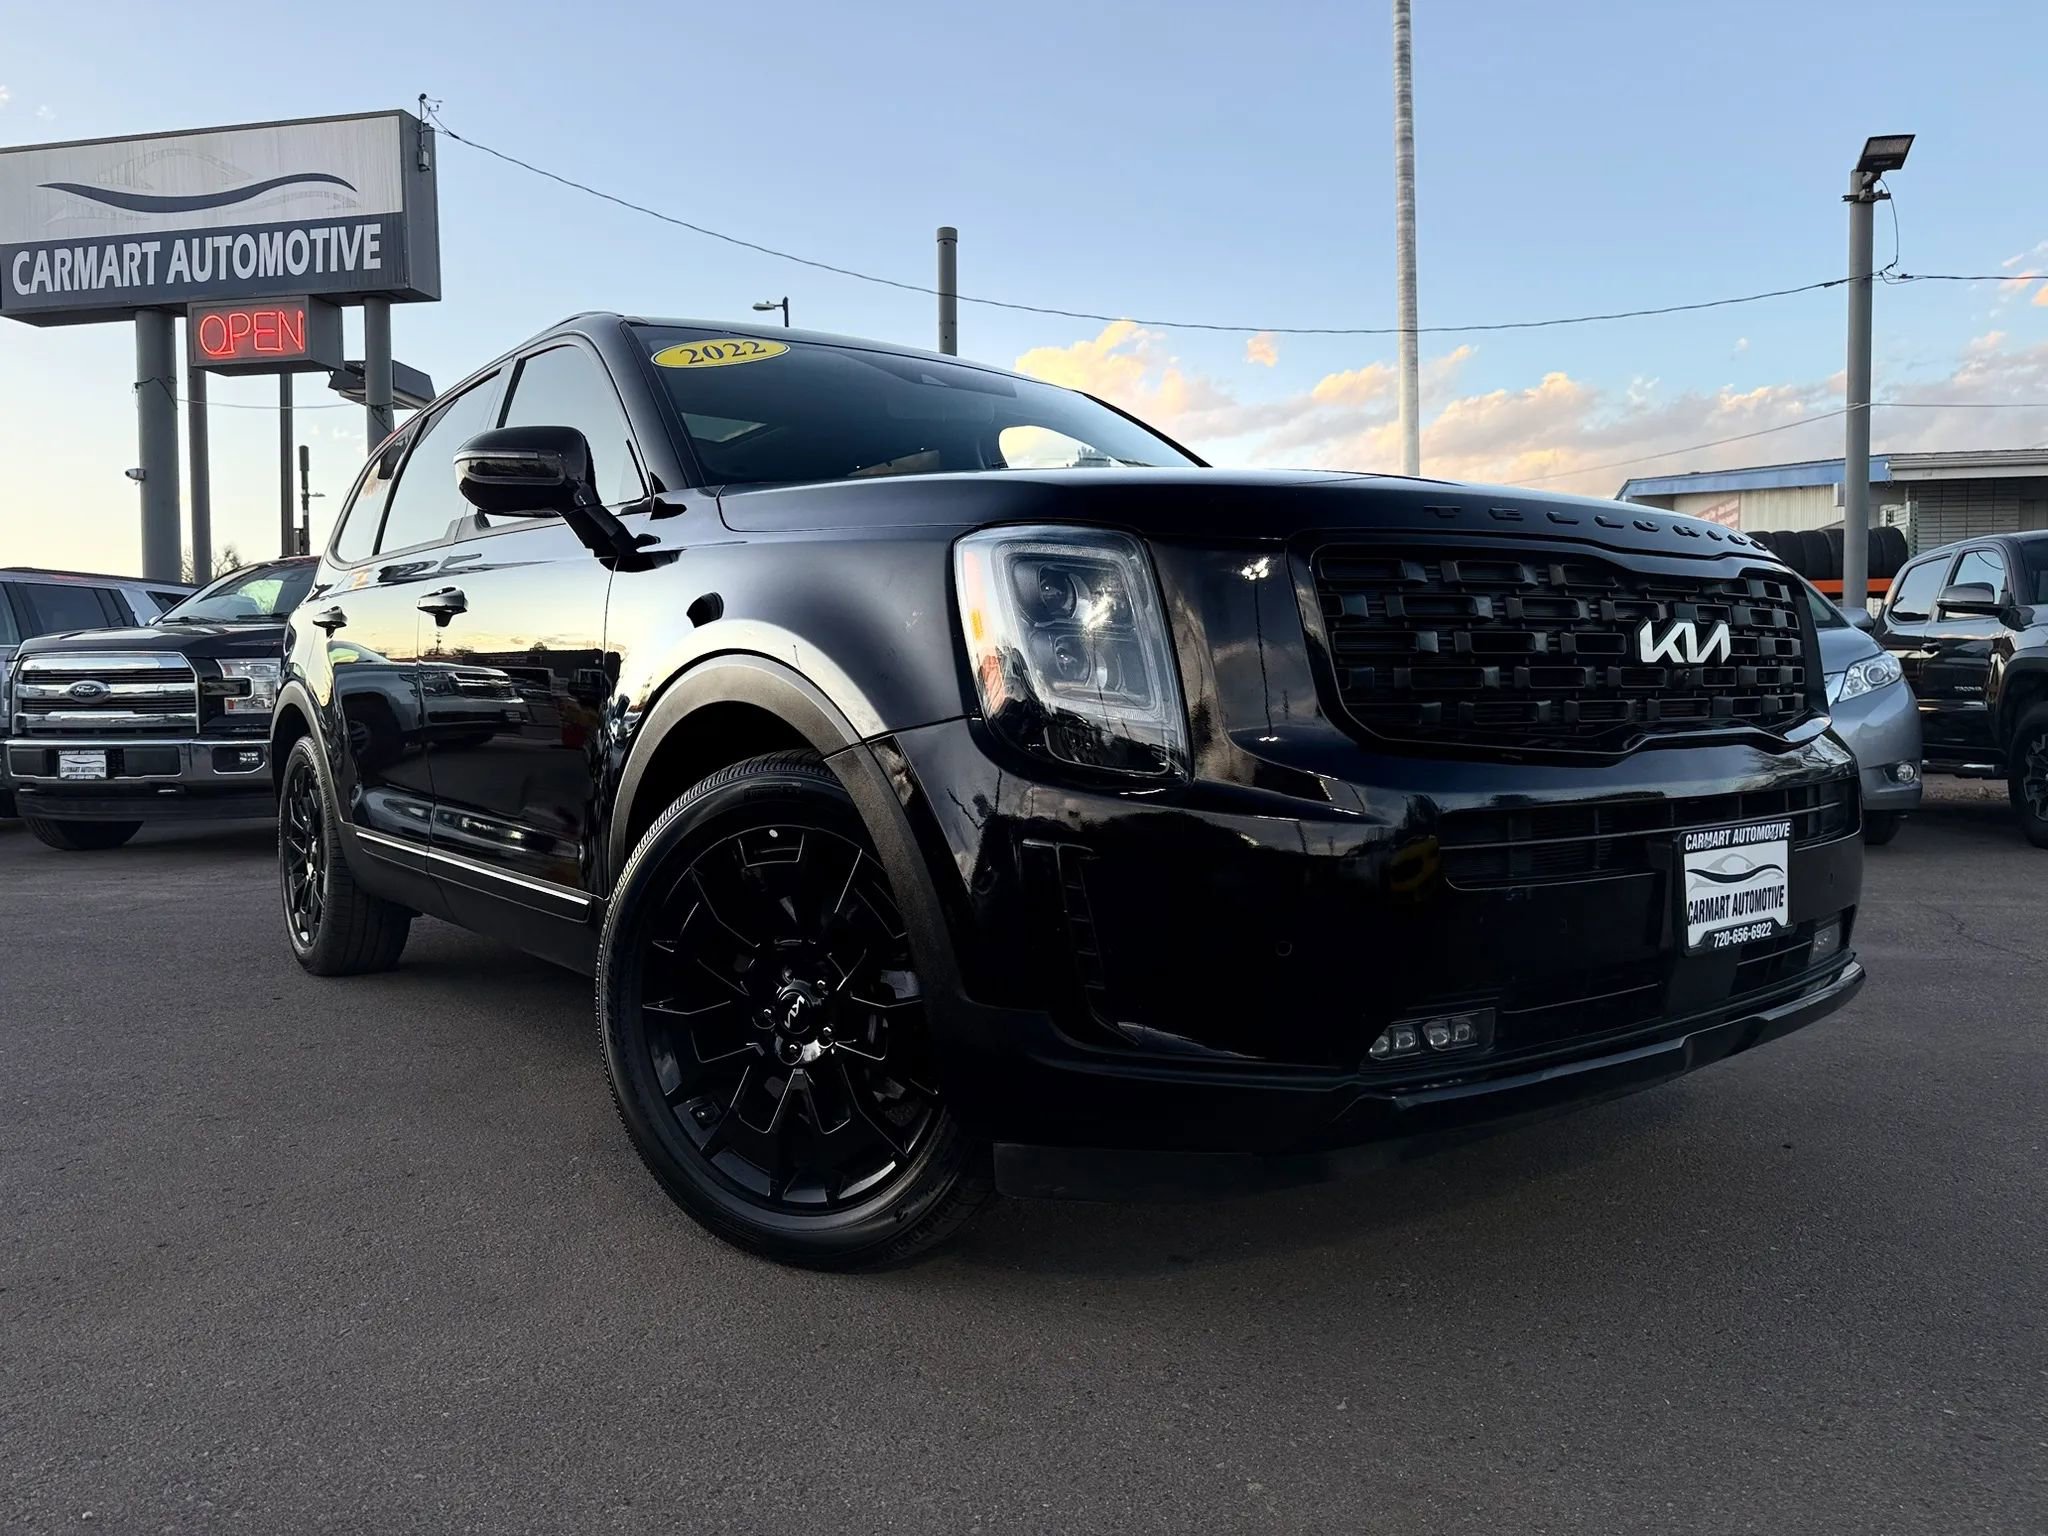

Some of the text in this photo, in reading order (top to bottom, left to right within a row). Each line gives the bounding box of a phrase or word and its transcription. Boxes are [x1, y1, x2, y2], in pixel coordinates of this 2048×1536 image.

[12, 224, 381, 295] CARMART AUTOMOTIVE
[199, 310, 304, 356] OPEN
[681, 341, 766, 364] 2022
[1639, 619, 1731, 664] KIA
[1685, 822, 1790, 850] CARMART AUTOMOTIVE
[1687, 885, 1784, 926] CARMART AUTOMOTIVE
[1714, 922, 1771, 947] 720-656-6922
